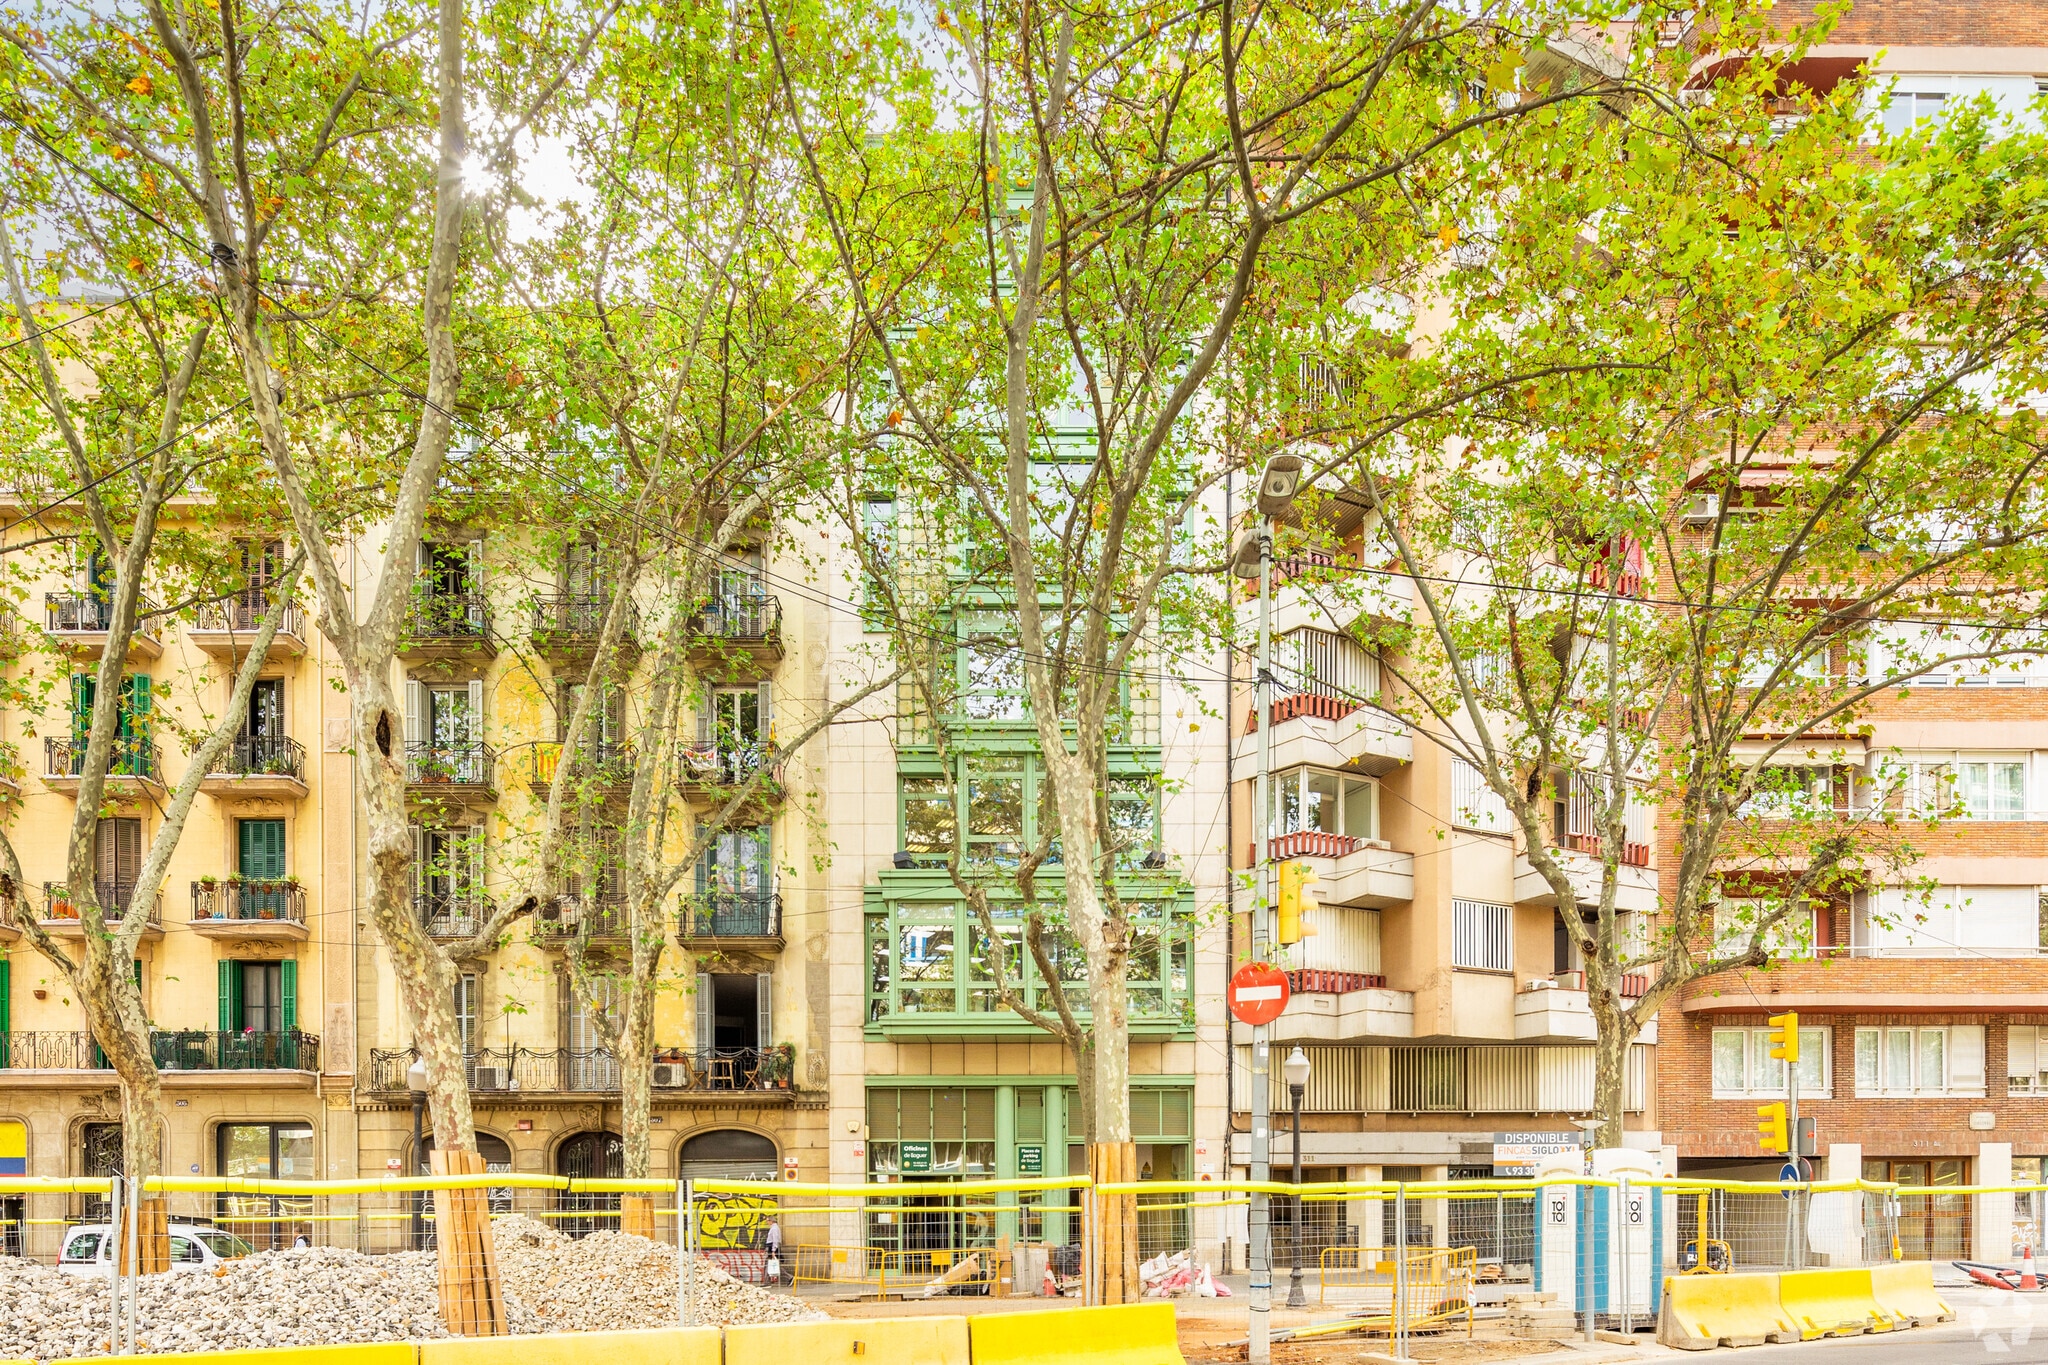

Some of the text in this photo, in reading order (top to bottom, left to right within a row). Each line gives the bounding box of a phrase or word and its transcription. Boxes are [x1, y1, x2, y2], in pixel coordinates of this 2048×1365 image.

[1505, 1133, 1569, 1143] DISPONIBLE
[1913, 1140, 1929, 1148] 311
[1512, 1166, 1523, 1175] 93
[1552, 1200, 1565, 1211] TOI
[1552, 1212, 1565, 1222] TOI
